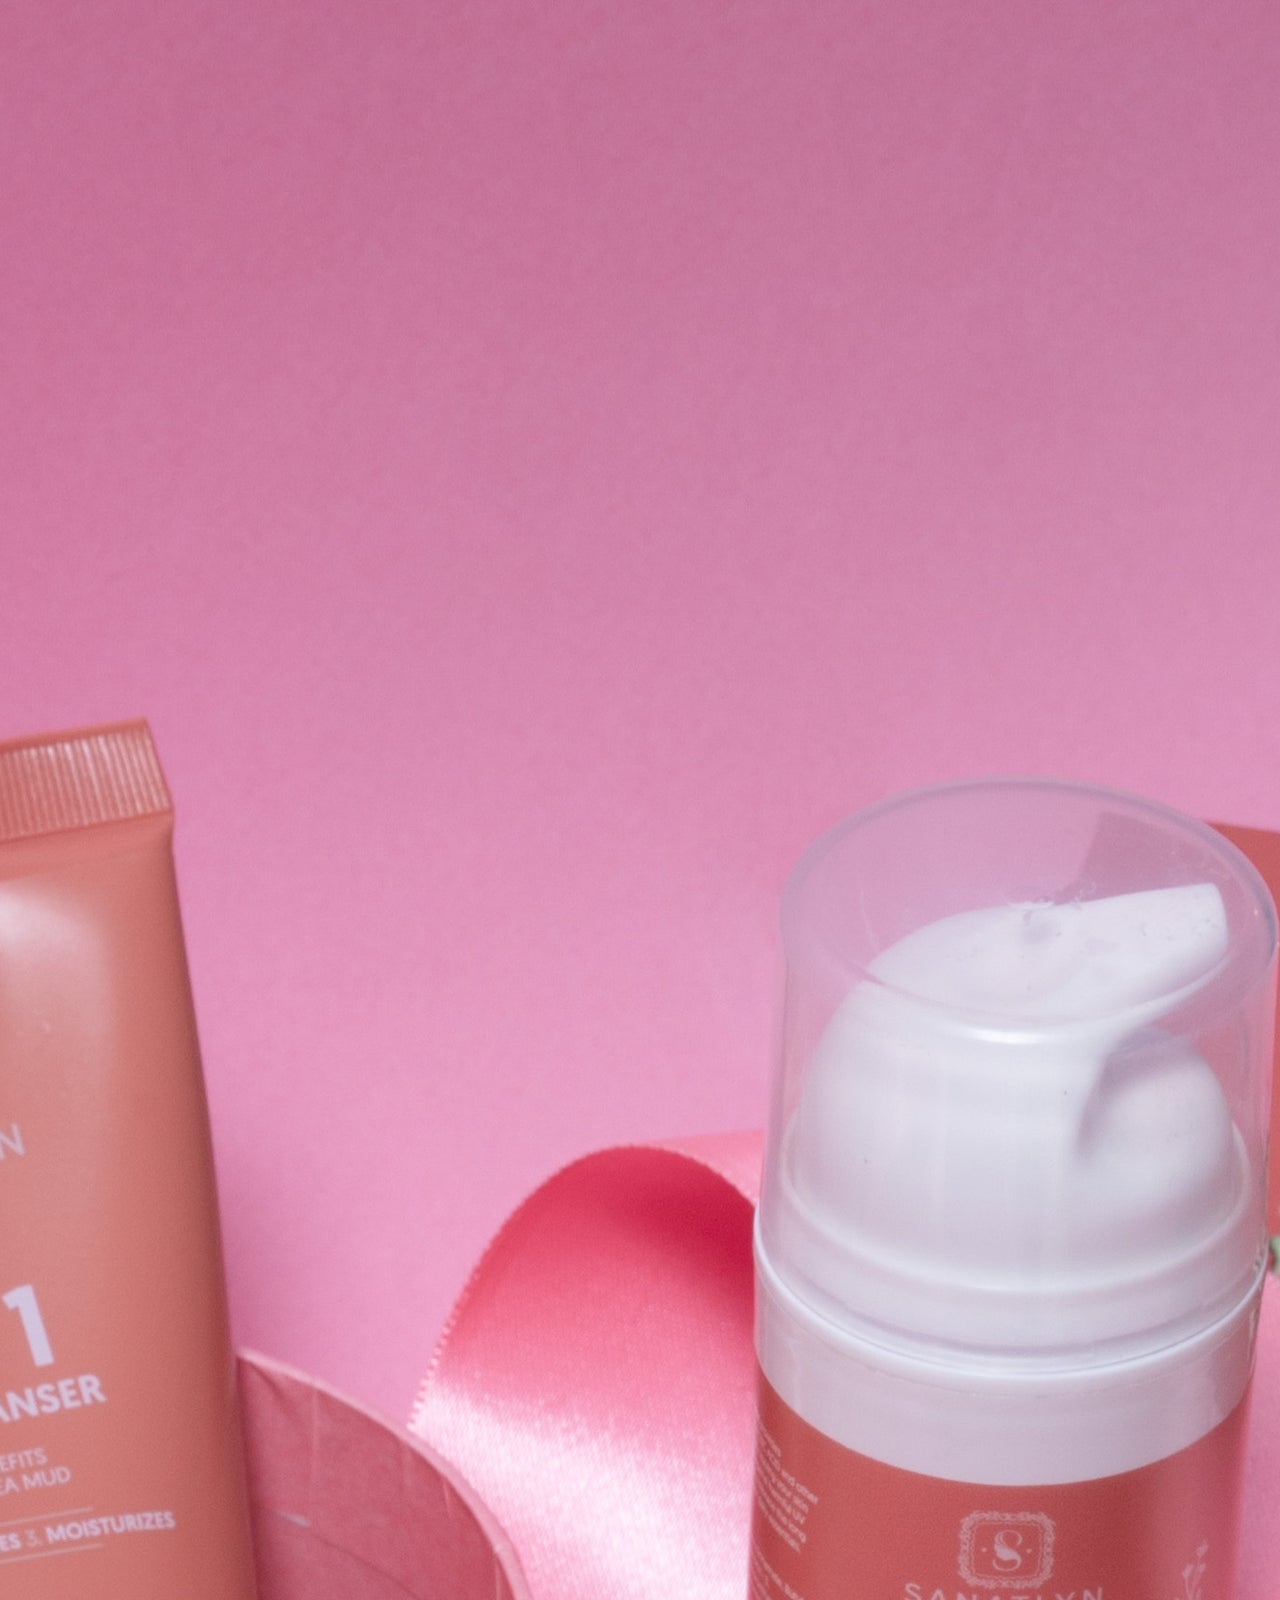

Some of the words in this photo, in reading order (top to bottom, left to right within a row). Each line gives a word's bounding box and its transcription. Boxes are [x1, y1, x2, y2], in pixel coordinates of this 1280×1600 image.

[2, 1284, 55, 1367] 1
[22, 1466, 72, 1489] MUD
[45, 1511, 175, 1544] MOISTURIZES
